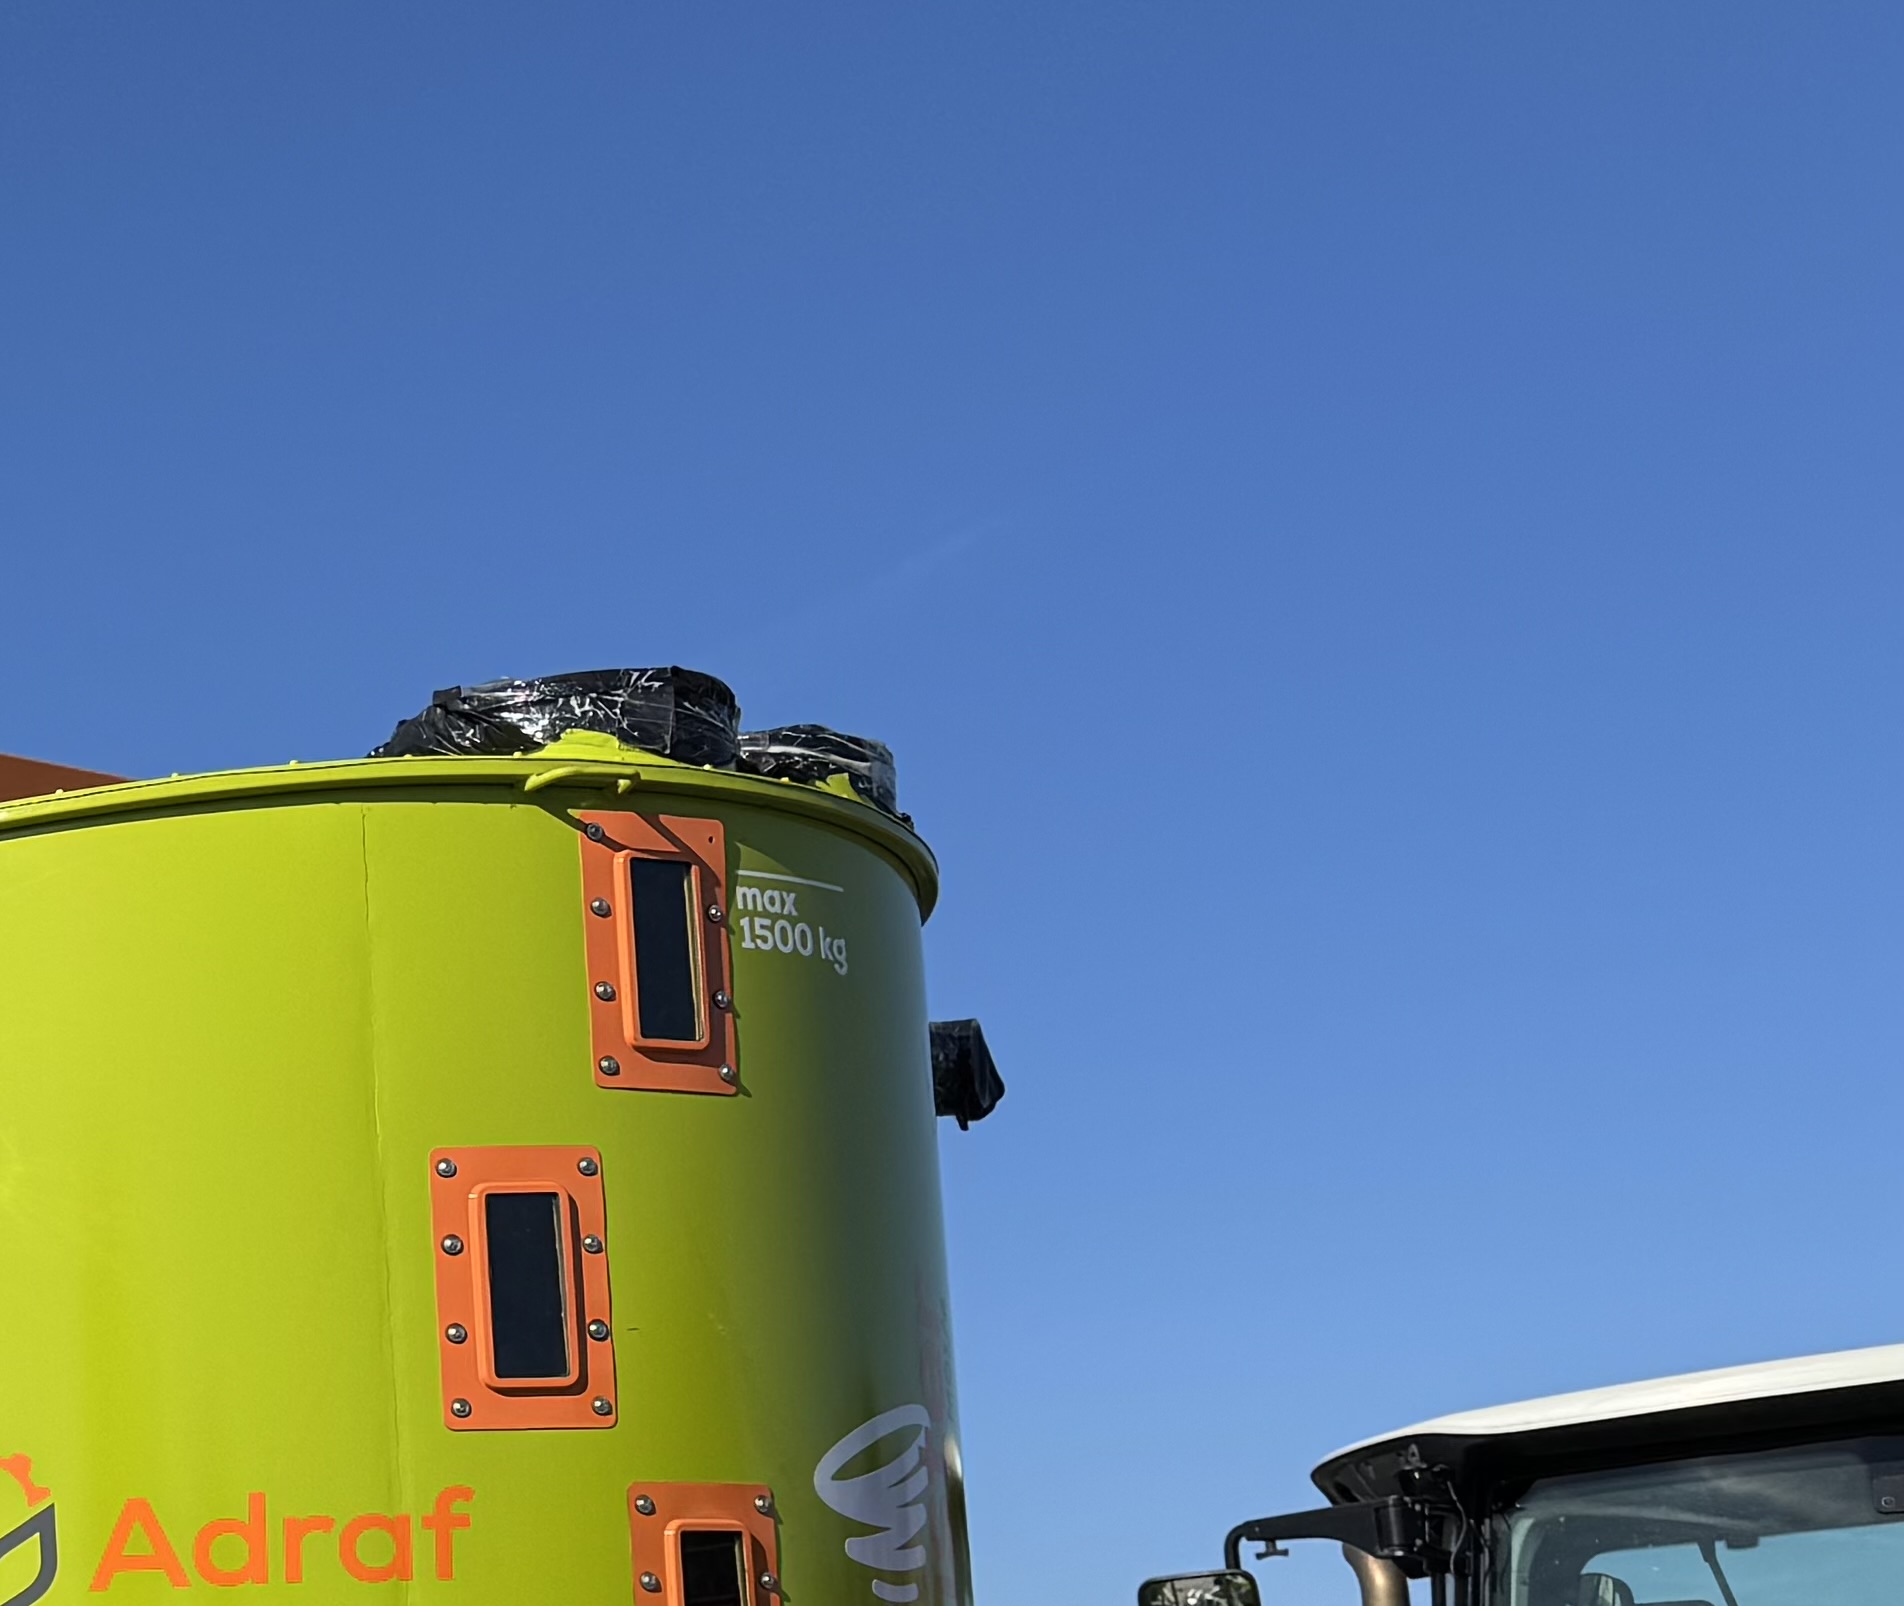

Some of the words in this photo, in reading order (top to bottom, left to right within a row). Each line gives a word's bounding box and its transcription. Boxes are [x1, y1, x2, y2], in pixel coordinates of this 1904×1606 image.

[735, 886, 798, 916] max
[739, 916, 813, 956] 1500
[818, 926, 848, 975] kg
[88, 1484, 476, 1592] Adraf
